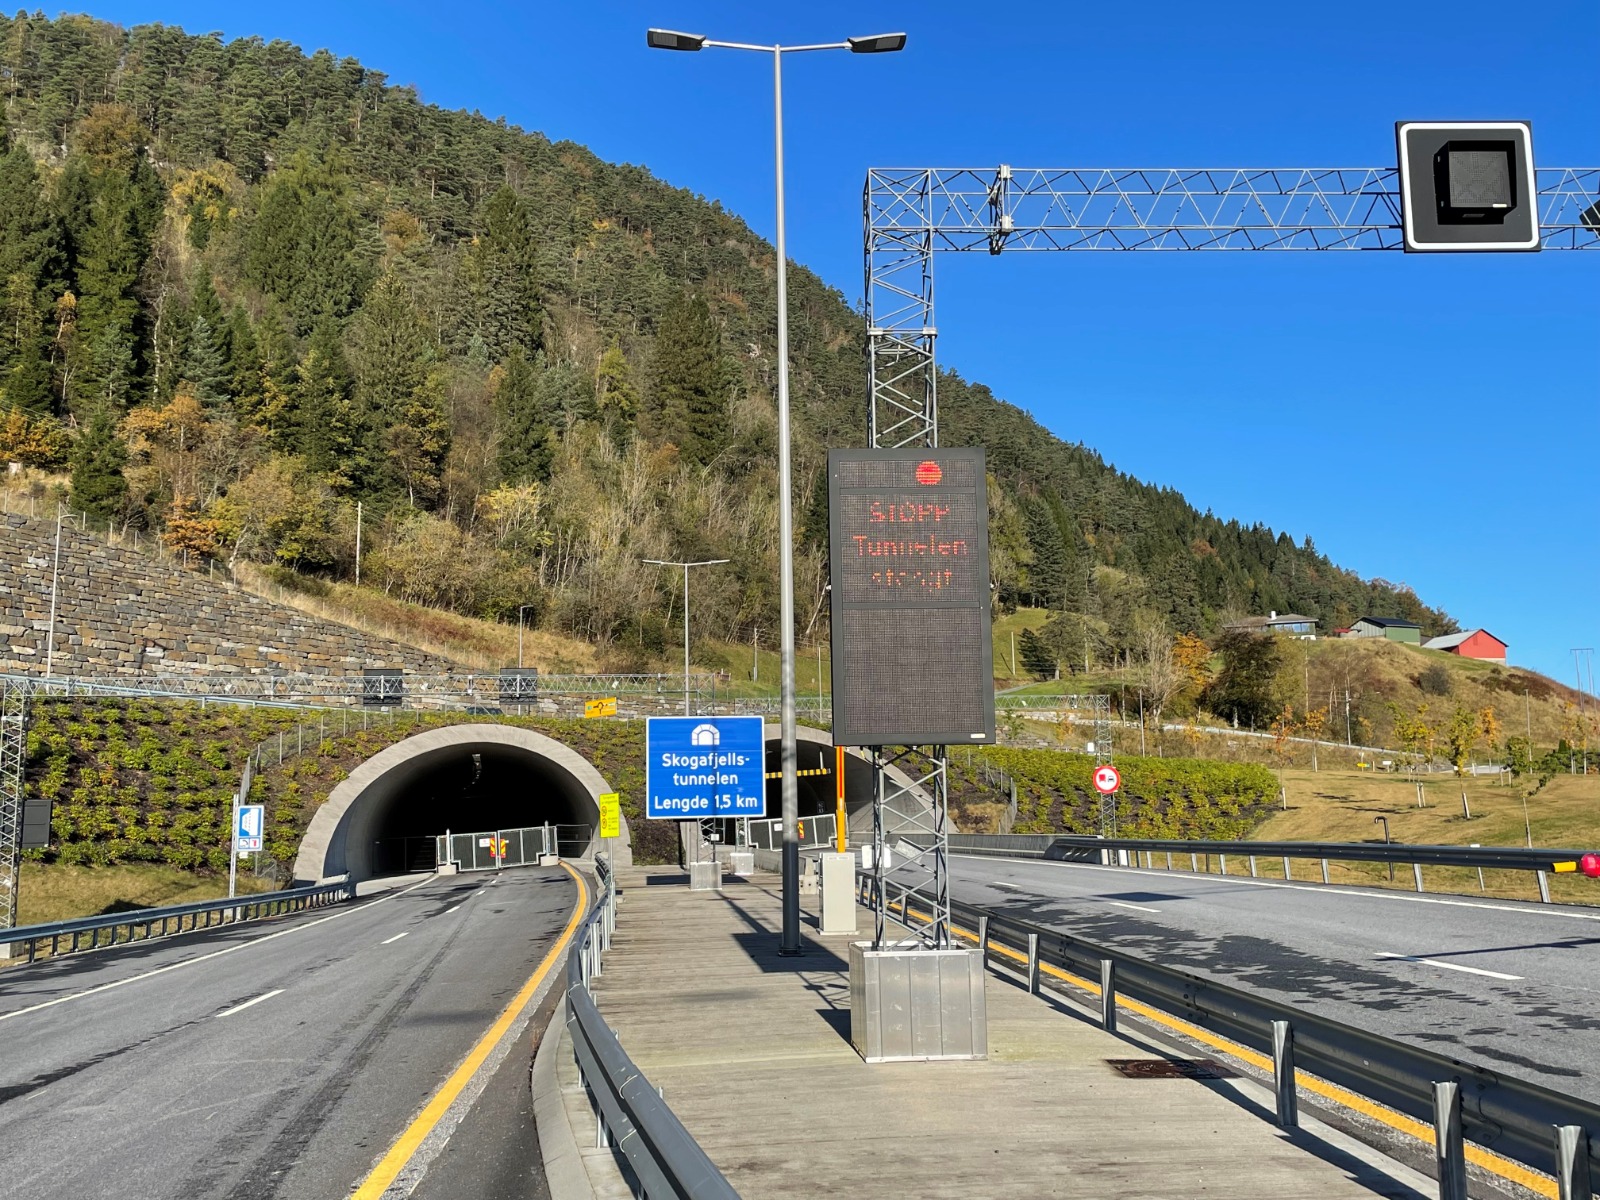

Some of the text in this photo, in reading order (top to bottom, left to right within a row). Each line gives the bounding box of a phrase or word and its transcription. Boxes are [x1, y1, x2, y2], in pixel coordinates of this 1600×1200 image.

[662, 752, 750, 770] Skogafjells-
[673, 772, 738, 786] tunnelen
[654, 794, 758, 812] Lengde 1,5 km
